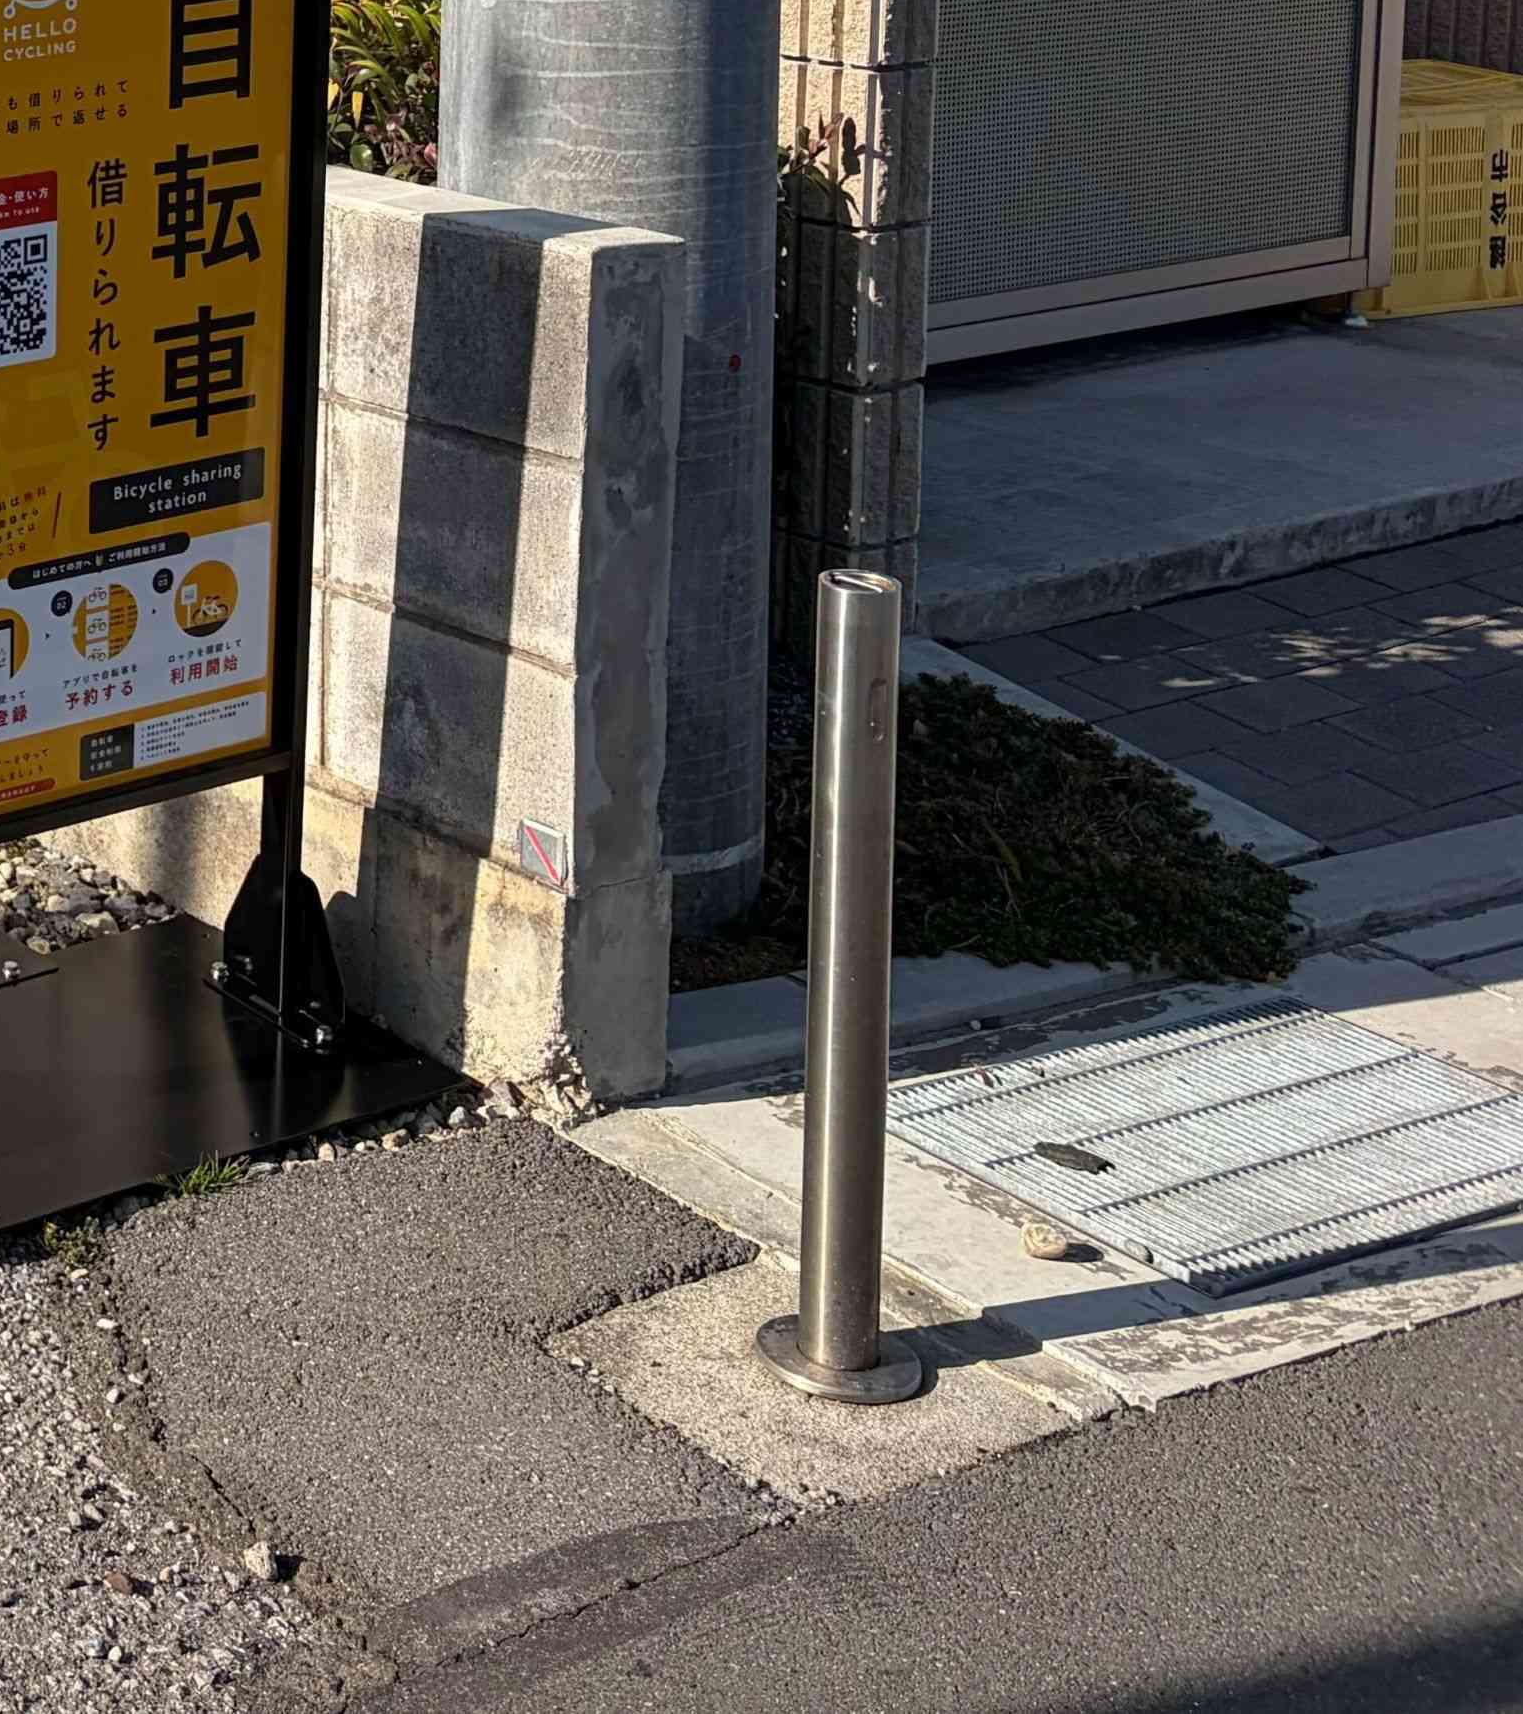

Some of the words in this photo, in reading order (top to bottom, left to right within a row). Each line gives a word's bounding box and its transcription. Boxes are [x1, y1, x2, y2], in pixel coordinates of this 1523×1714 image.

[2, 18, 78, 44] HELLO
[2, 40, 77, 63] CYCLING
[87, 158, 128, 451] 借りられます
[113, 475, 173, 501] Bicycle
[182, 463, 242, 486] sharing
[148, 491, 207, 513] station
[169, 654, 239, 686] 利用開始
[64, 680, 134, 711] 予約する
